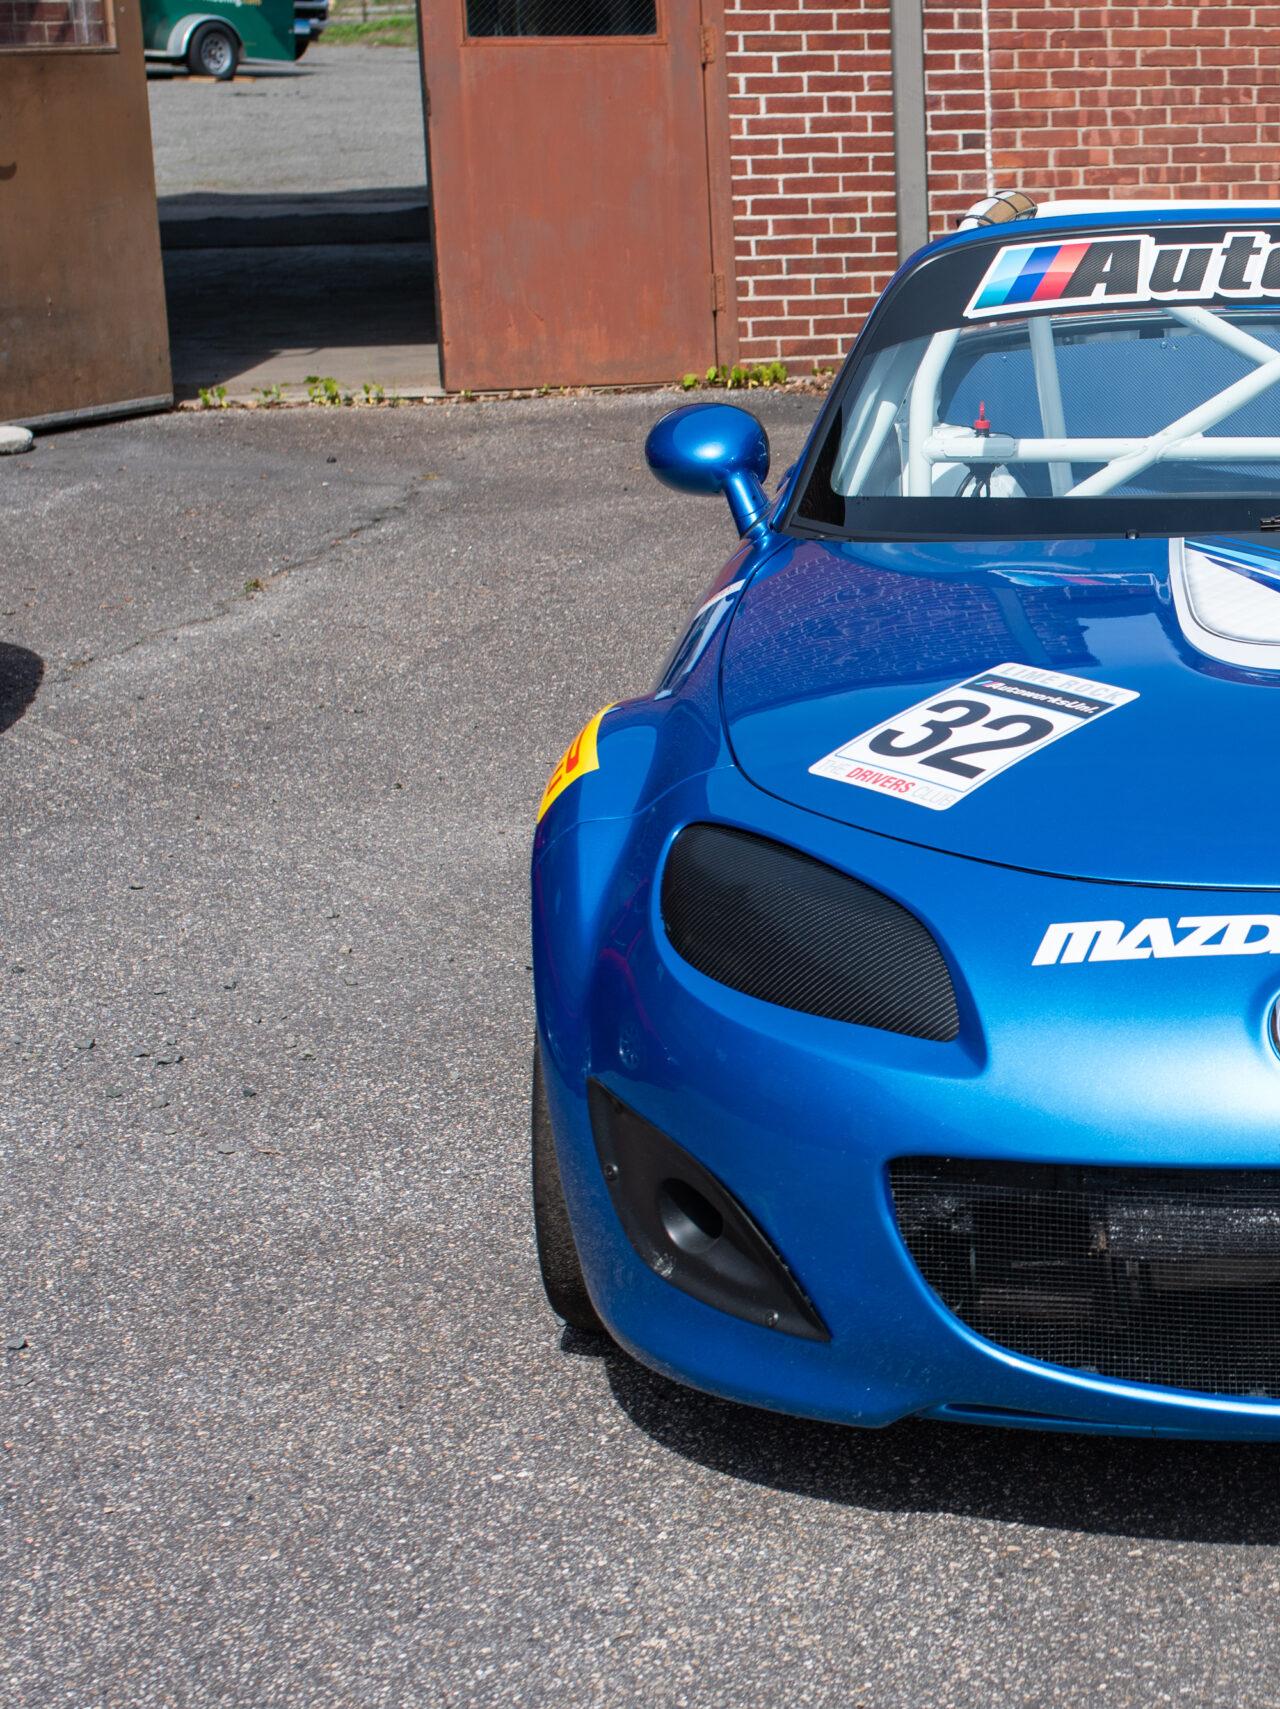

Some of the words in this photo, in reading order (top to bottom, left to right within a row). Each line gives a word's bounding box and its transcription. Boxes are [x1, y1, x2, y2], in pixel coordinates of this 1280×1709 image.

[1059, 679, 1126, 702] ROCK
[868, 699, 1054, 779] 32
[845, 767, 916, 794] DRIVERS
